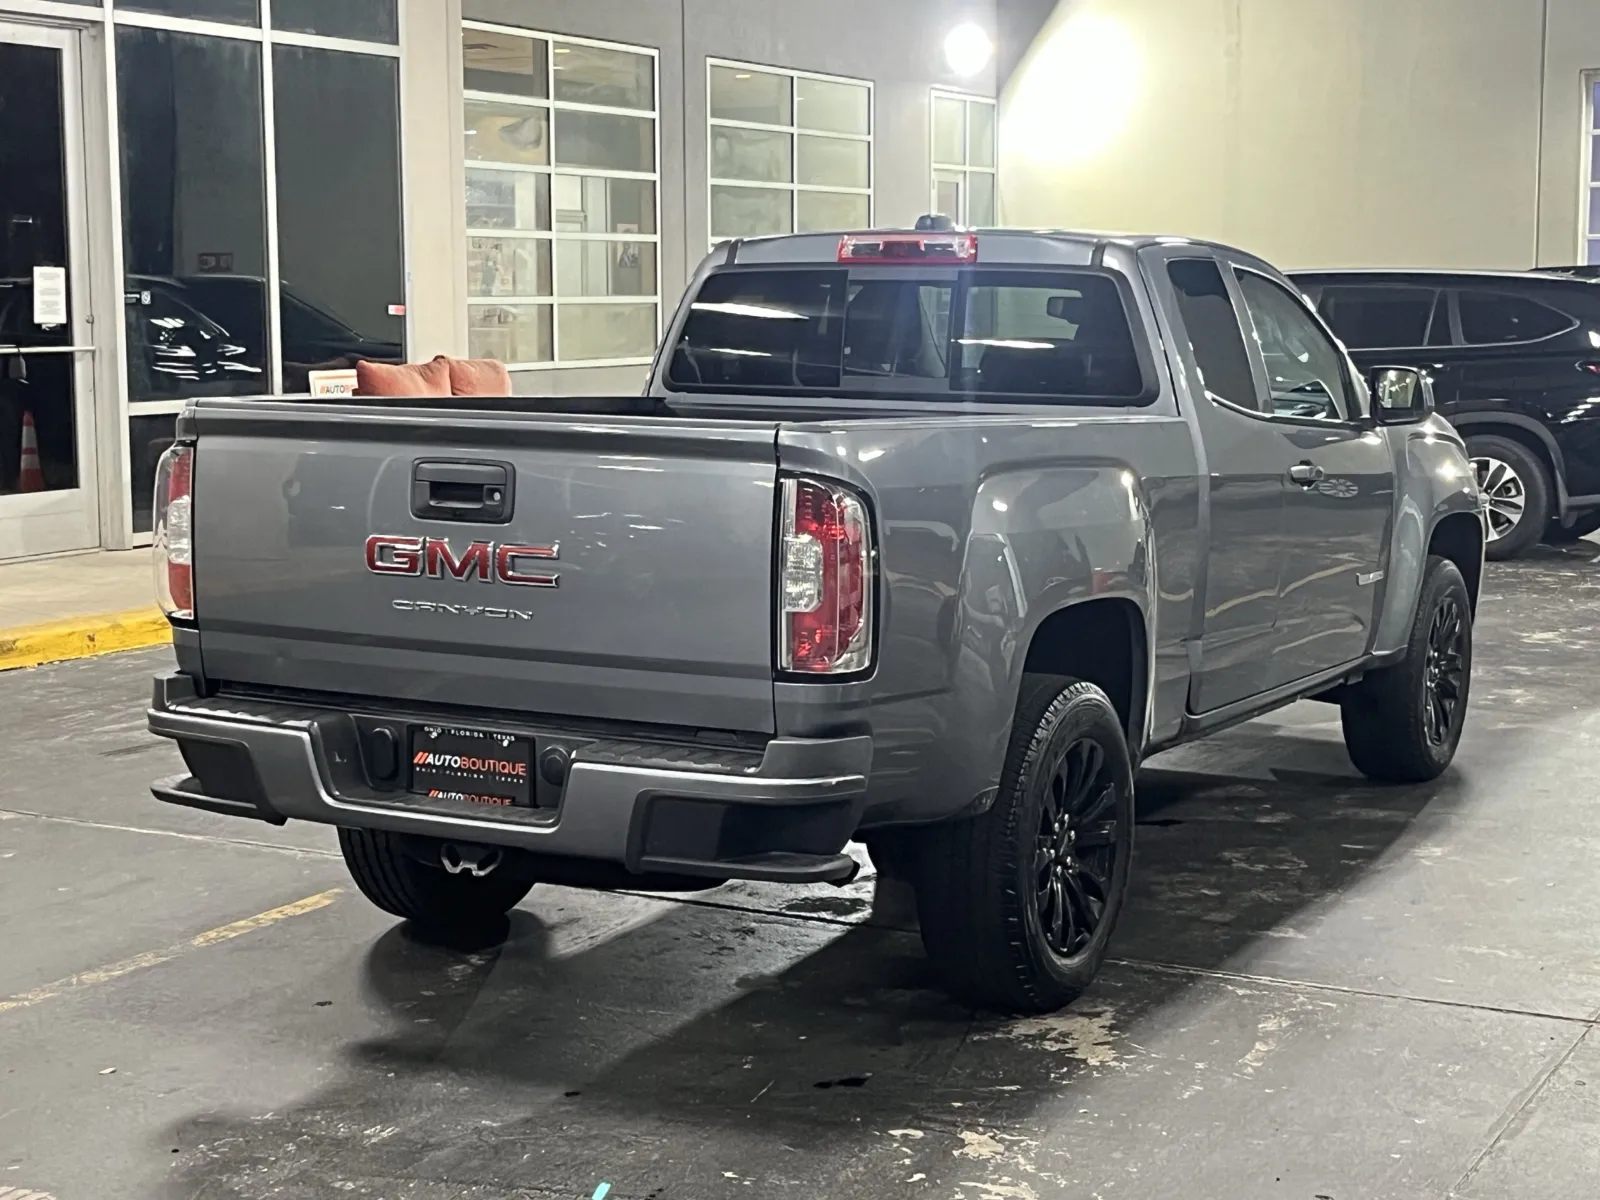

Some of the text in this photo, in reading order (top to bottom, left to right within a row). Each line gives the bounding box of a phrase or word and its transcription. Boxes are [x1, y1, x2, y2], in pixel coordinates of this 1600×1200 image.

[366, 534, 560, 587] GMC
[392, 599, 534, 620] CANYON
[451, 729, 484, 738] FLORIDA
[493, 733, 516, 741] TEXAS
[424, 752, 527, 776] AUTOBOUTIQUE
